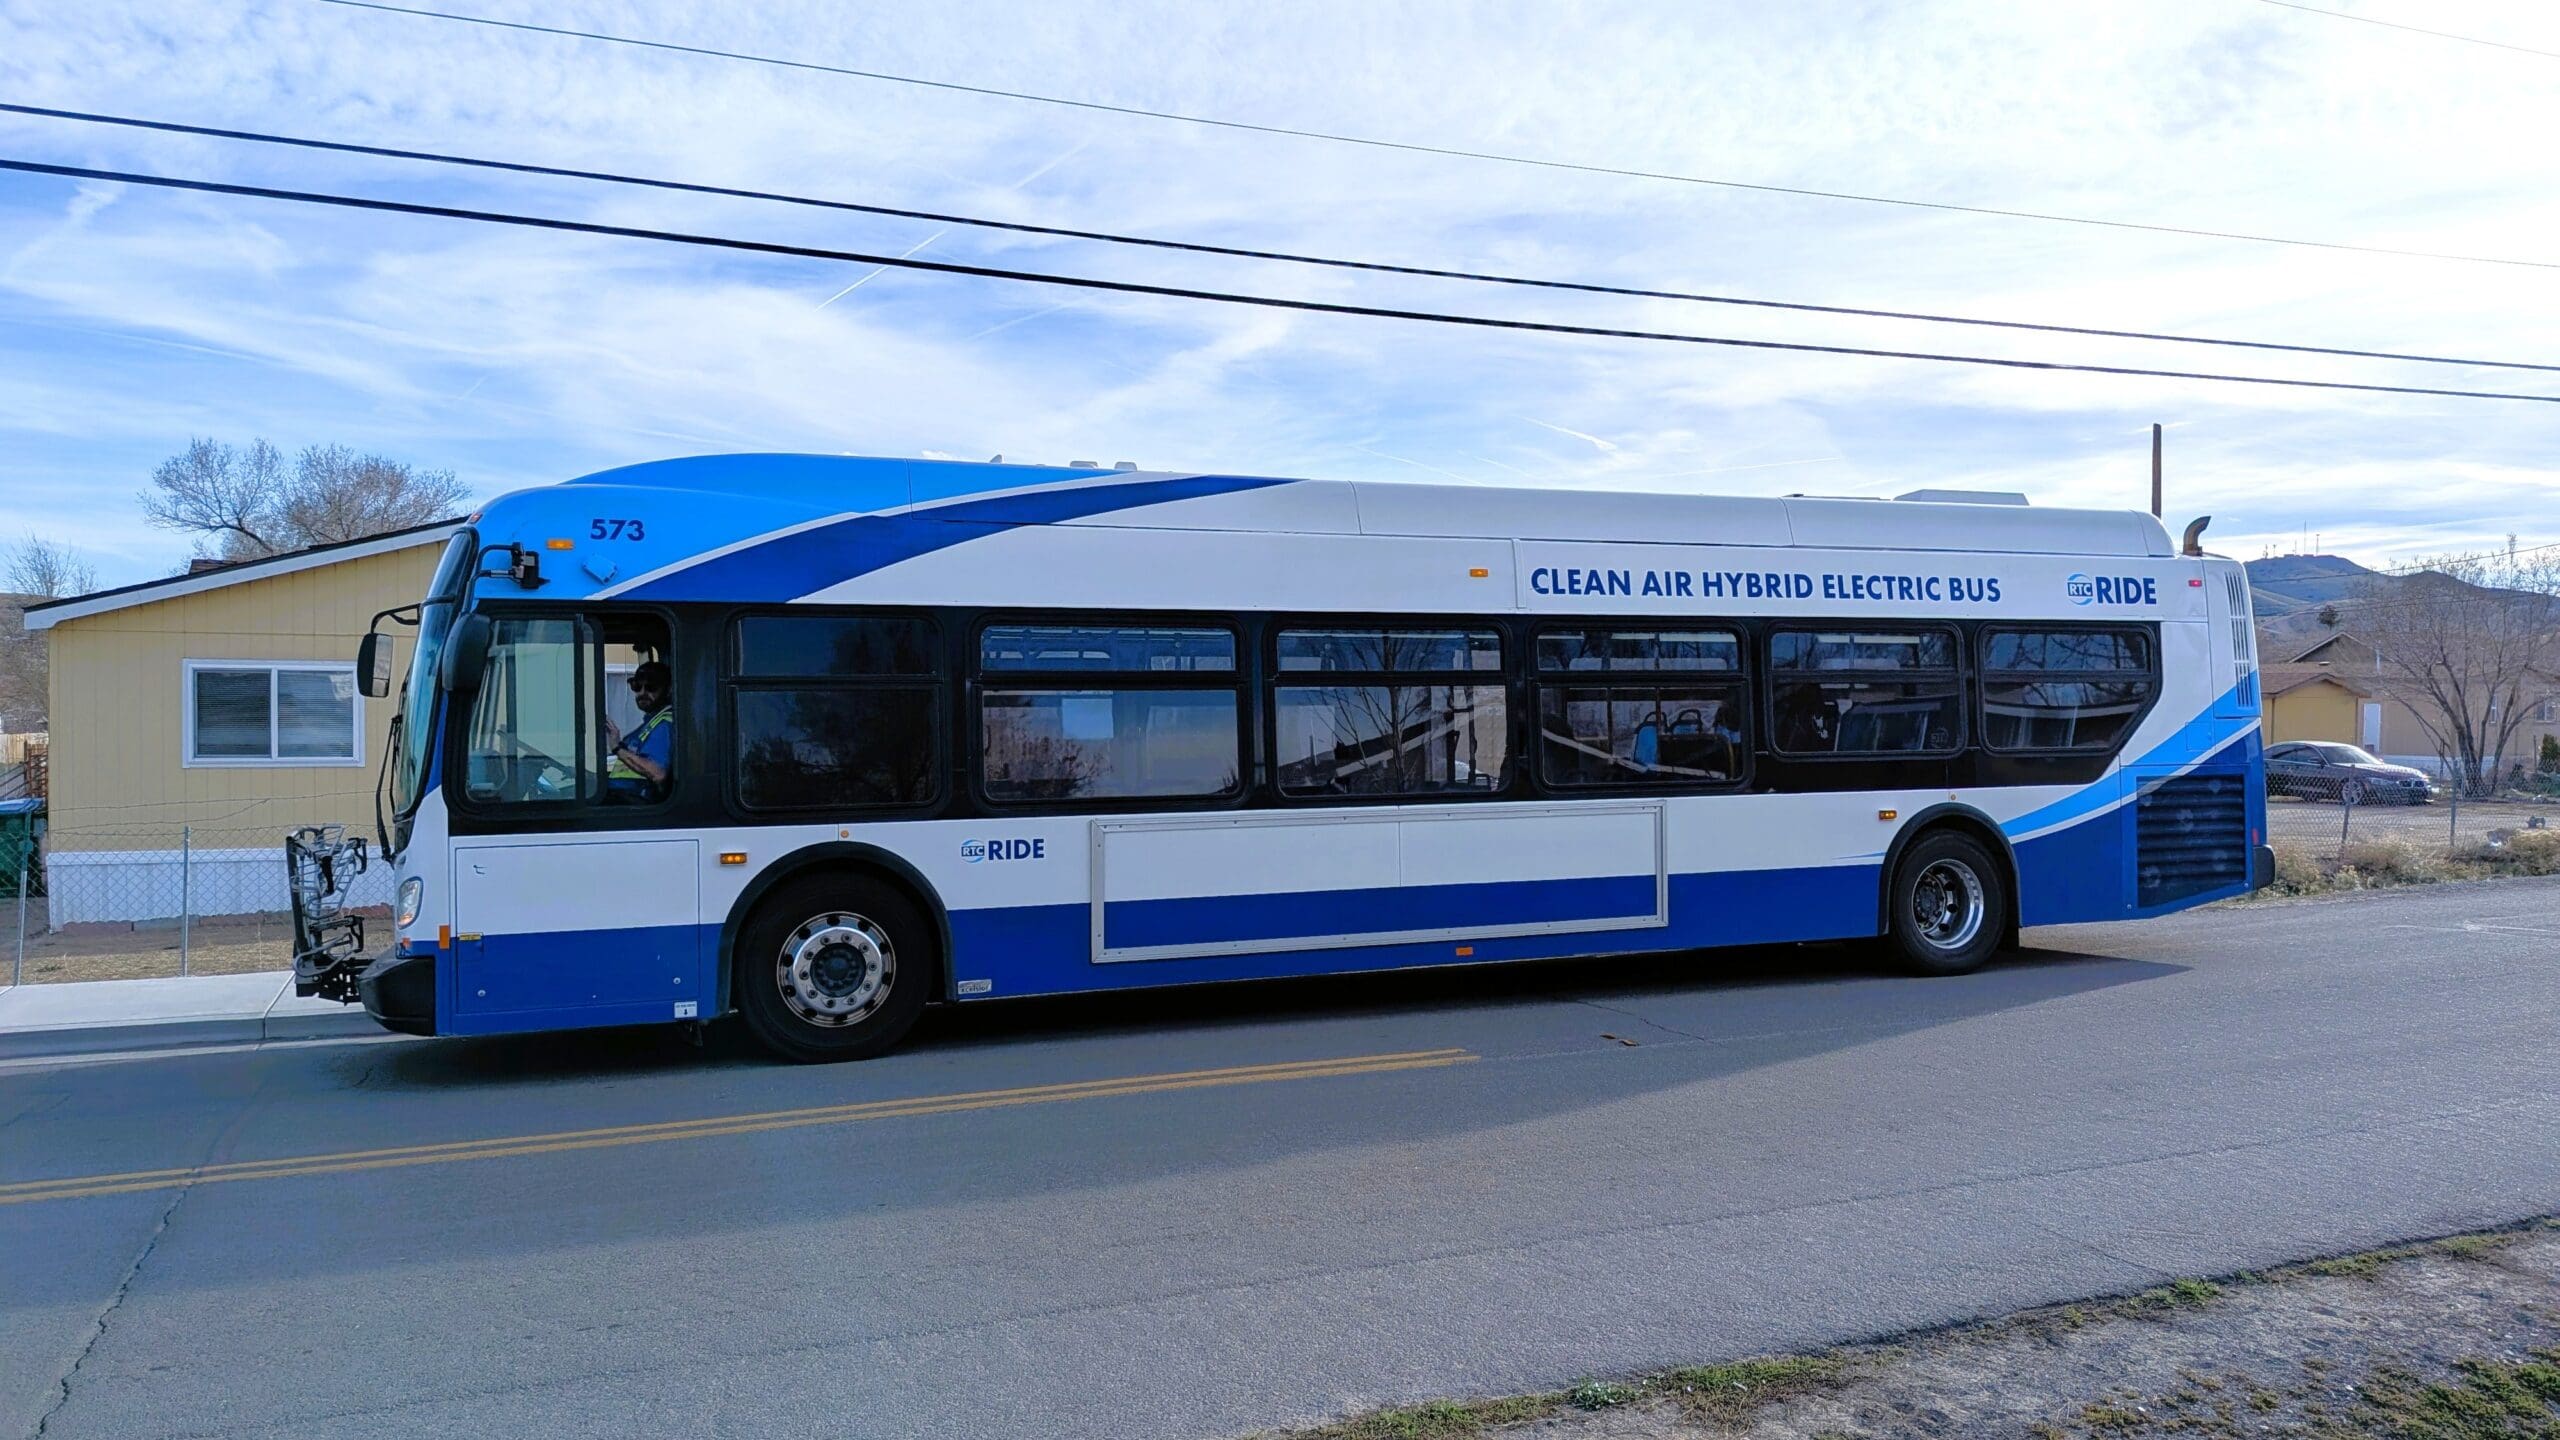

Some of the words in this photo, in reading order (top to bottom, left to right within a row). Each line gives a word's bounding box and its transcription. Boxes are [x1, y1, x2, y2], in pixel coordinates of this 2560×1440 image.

[590, 518, 645, 541] 573
[1531, 567, 1631, 596] CLEAN
[1641, 570, 1694, 597] AIR
[1702, 572, 1813, 599] HYBRID
[1822, 574, 1941, 601] ELECTRIC
[1949, 577, 2001, 602] BUS
[2067, 582, 2093, 597] RTC
[2096, 576, 2157, 604] RIDE
[961, 845, 985, 857] RTC
[988, 838, 1045, 861] RIDE
